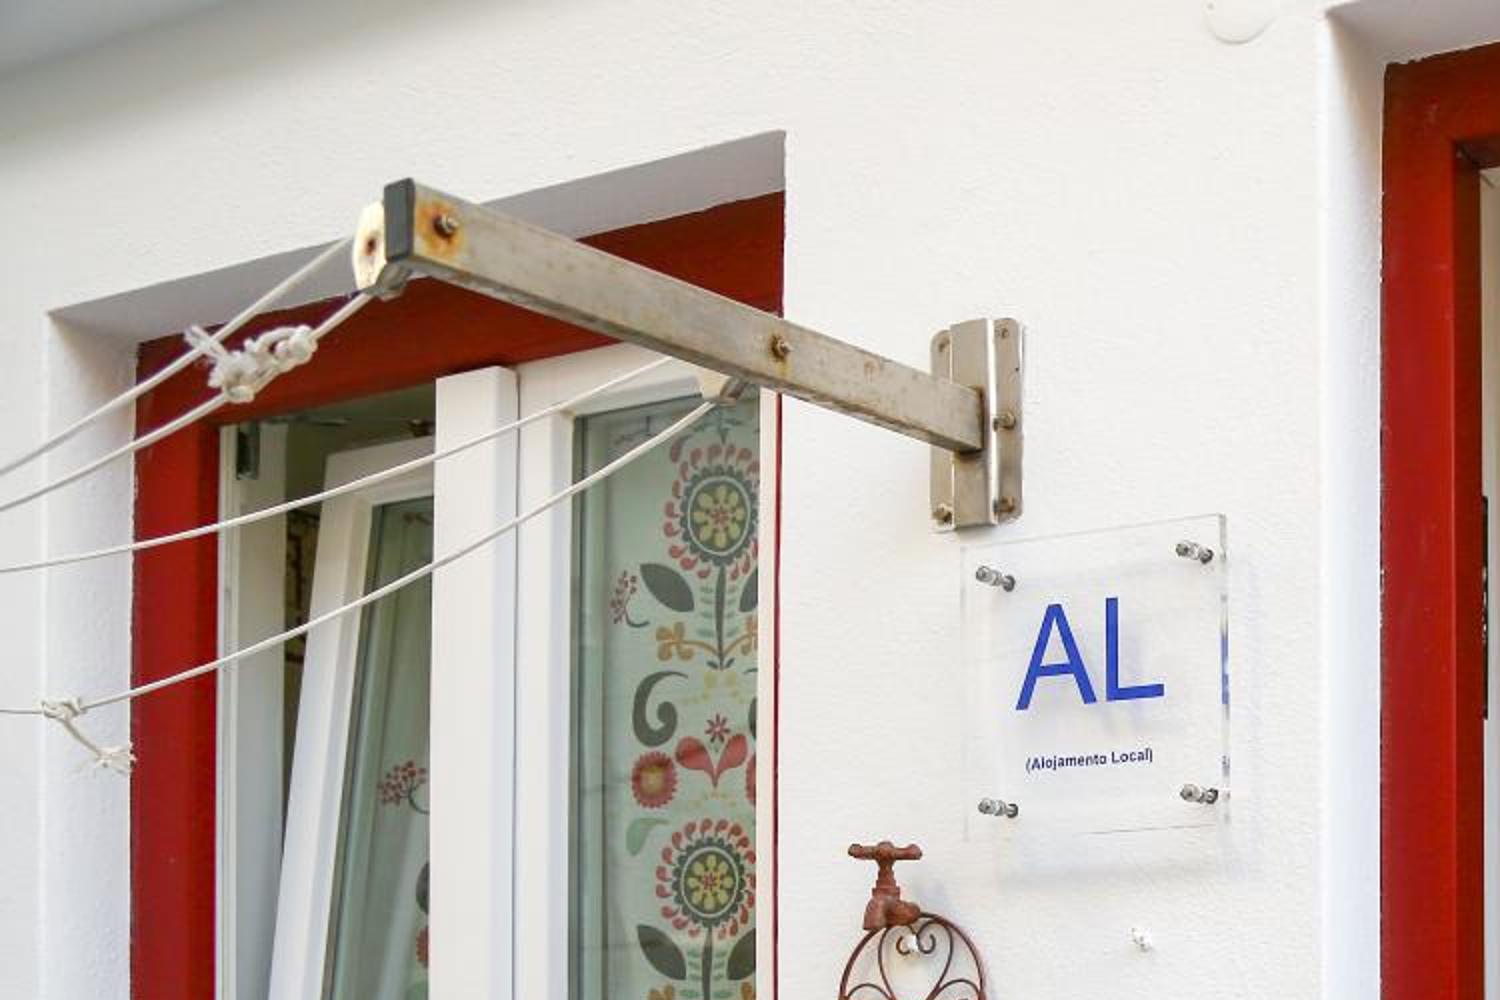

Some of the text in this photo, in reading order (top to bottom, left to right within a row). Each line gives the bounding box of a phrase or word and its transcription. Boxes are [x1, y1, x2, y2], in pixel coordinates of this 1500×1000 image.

[1016, 597, 1164, 710] AL
[1025, 748, 1153, 773] (Alojamento Local)
